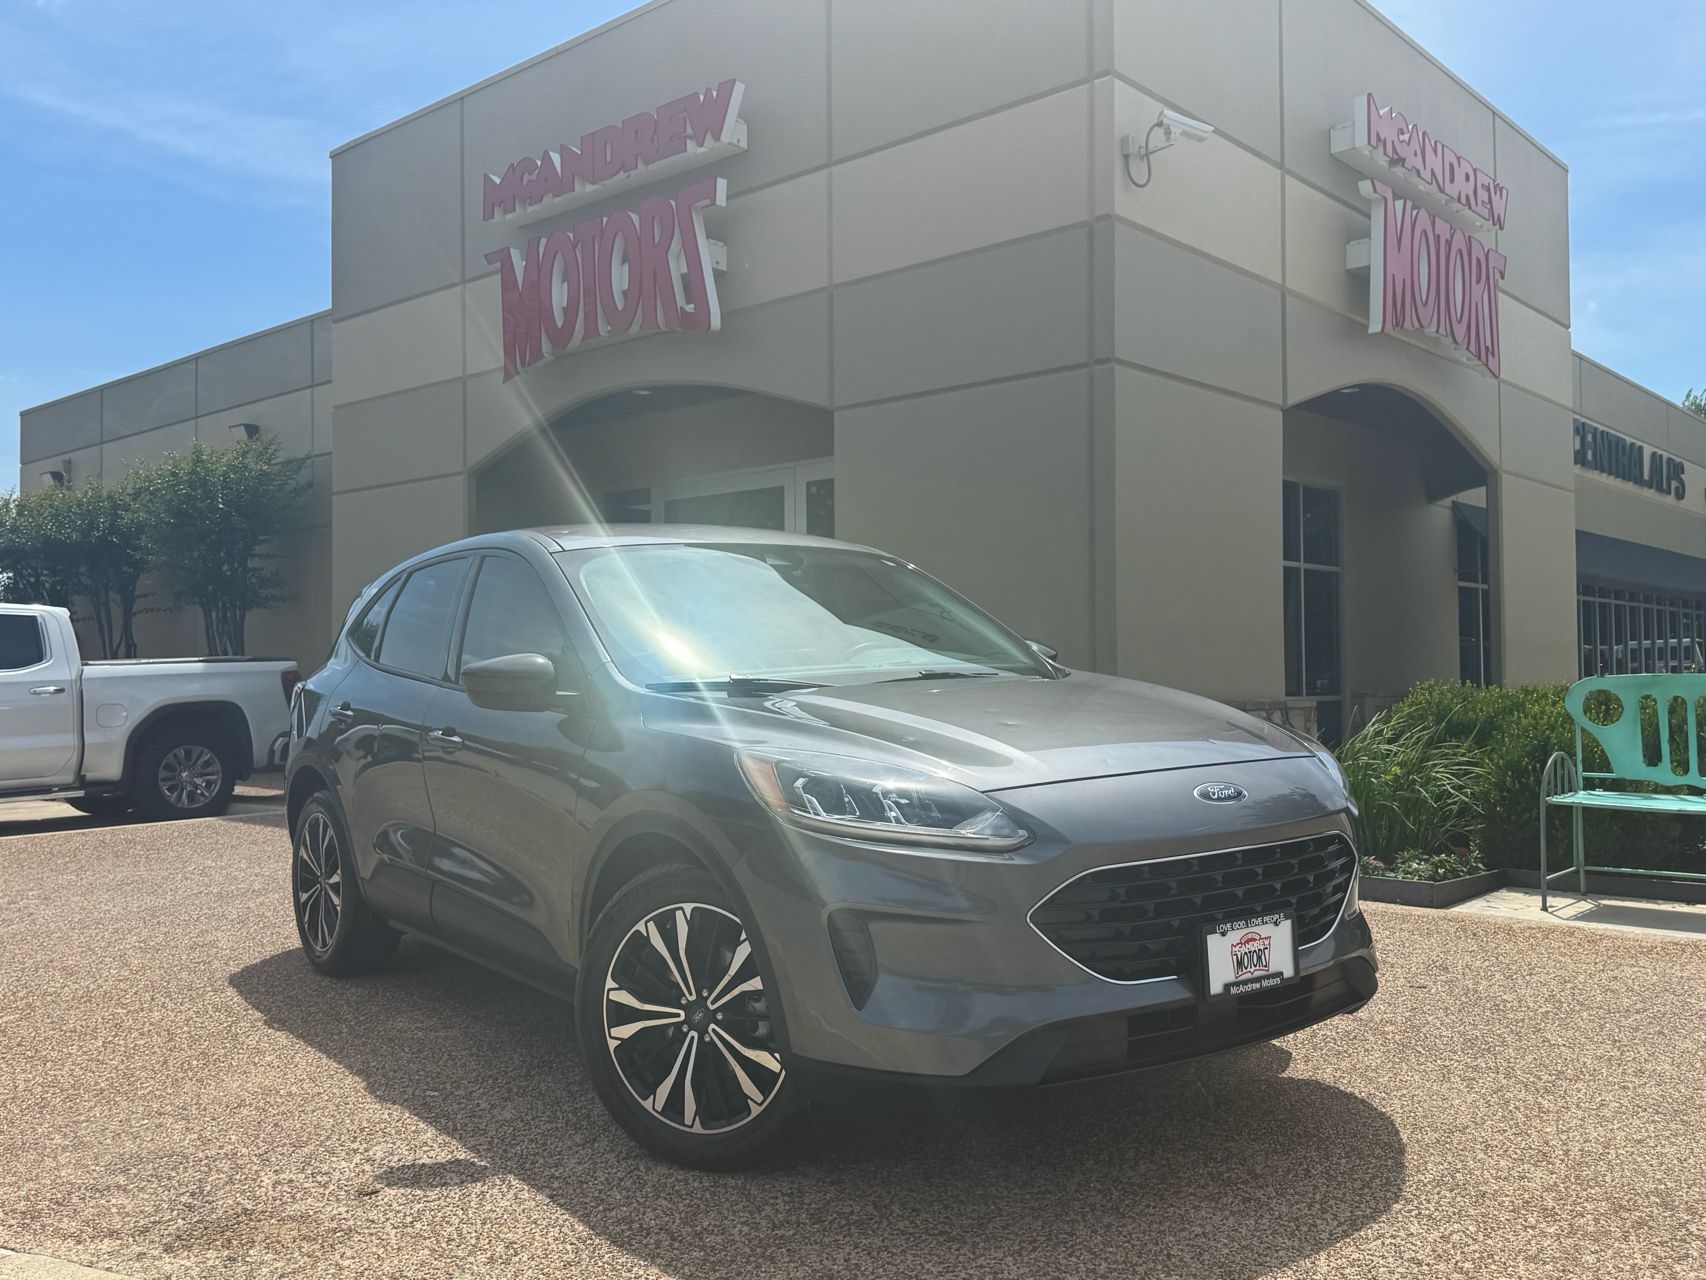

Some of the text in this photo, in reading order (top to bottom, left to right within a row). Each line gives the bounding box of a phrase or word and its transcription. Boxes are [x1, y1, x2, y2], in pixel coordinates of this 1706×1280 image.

[484, 176, 722, 384] MOTORS
[1370, 177, 1507, 380] MOTORS
[1572, 418, 1651, 490] CENTRAL
[1207, 785, 1235, 799] Ford
[1216, 923, 1232, 933] LOVE
[1232, 920, 1247, 930] GOD.
[1247, 917, 1263, 927] LOVE
[1233, 946, 1269, 975] MOTORS
[1230, 977, 1281, 995] McAndrew Motors
